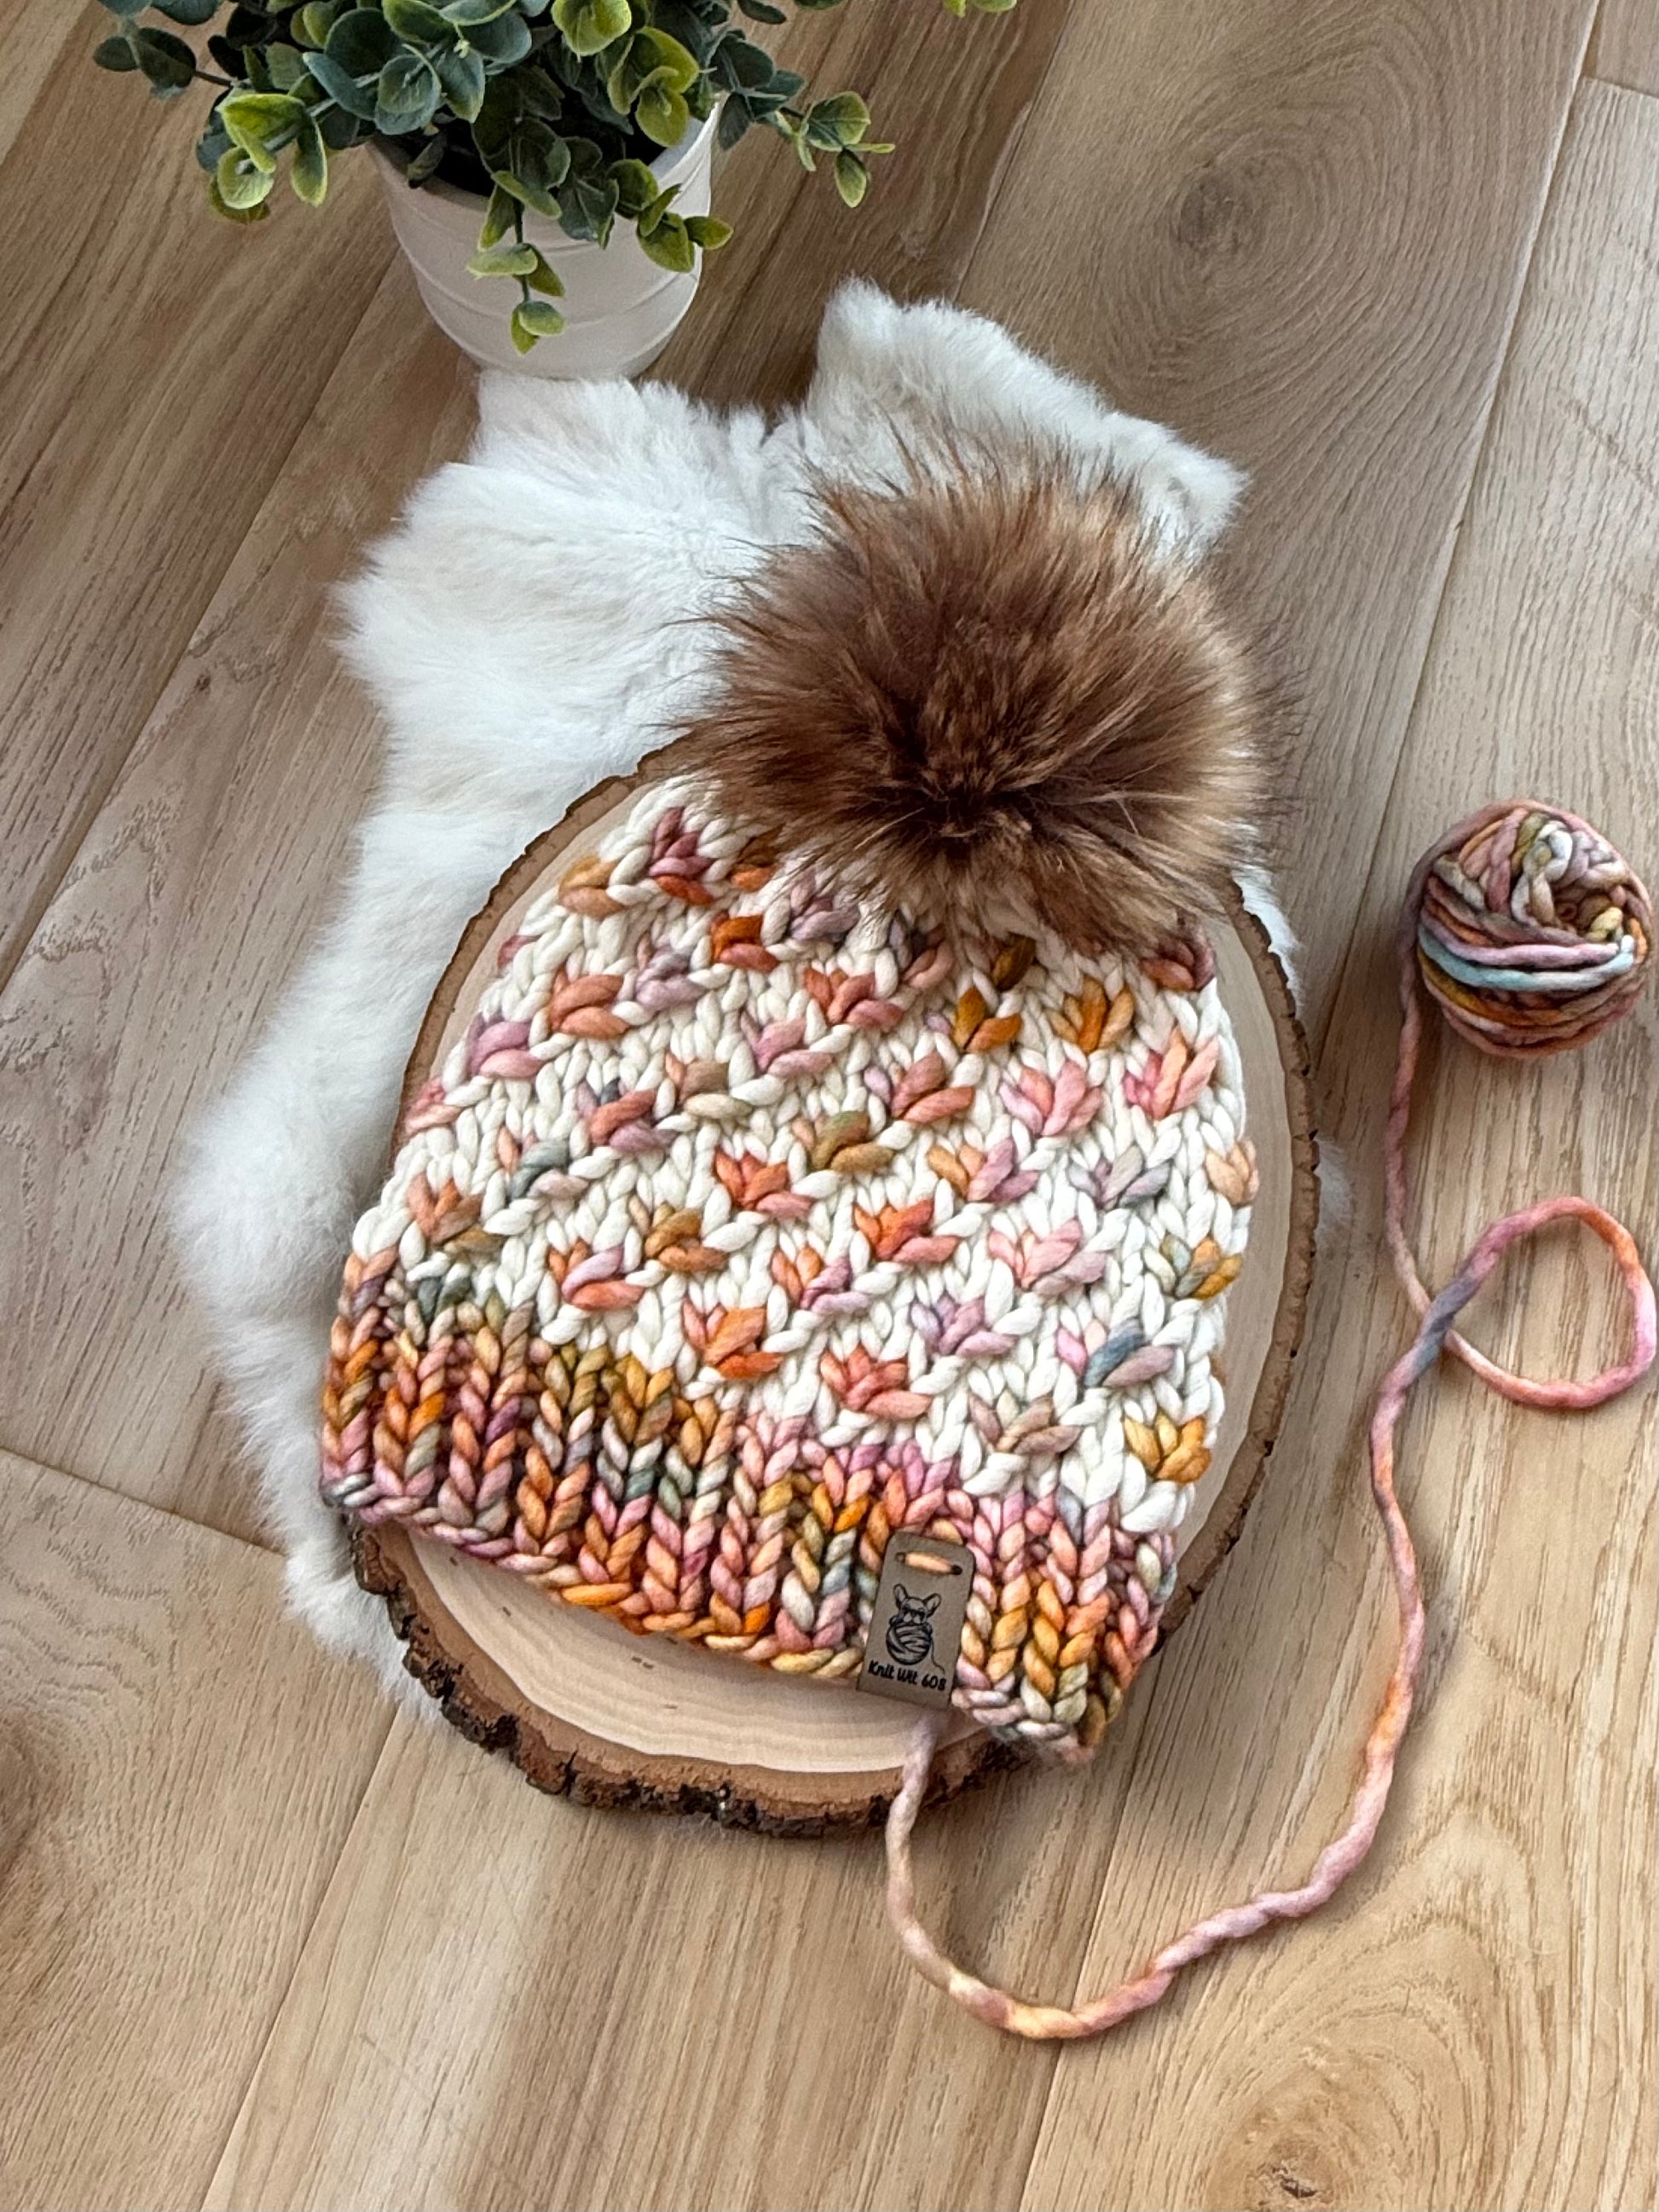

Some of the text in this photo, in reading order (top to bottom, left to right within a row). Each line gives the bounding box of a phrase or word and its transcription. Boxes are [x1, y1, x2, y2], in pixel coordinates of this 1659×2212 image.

[868, 1660, 947, 1691] Knit Wit 608
